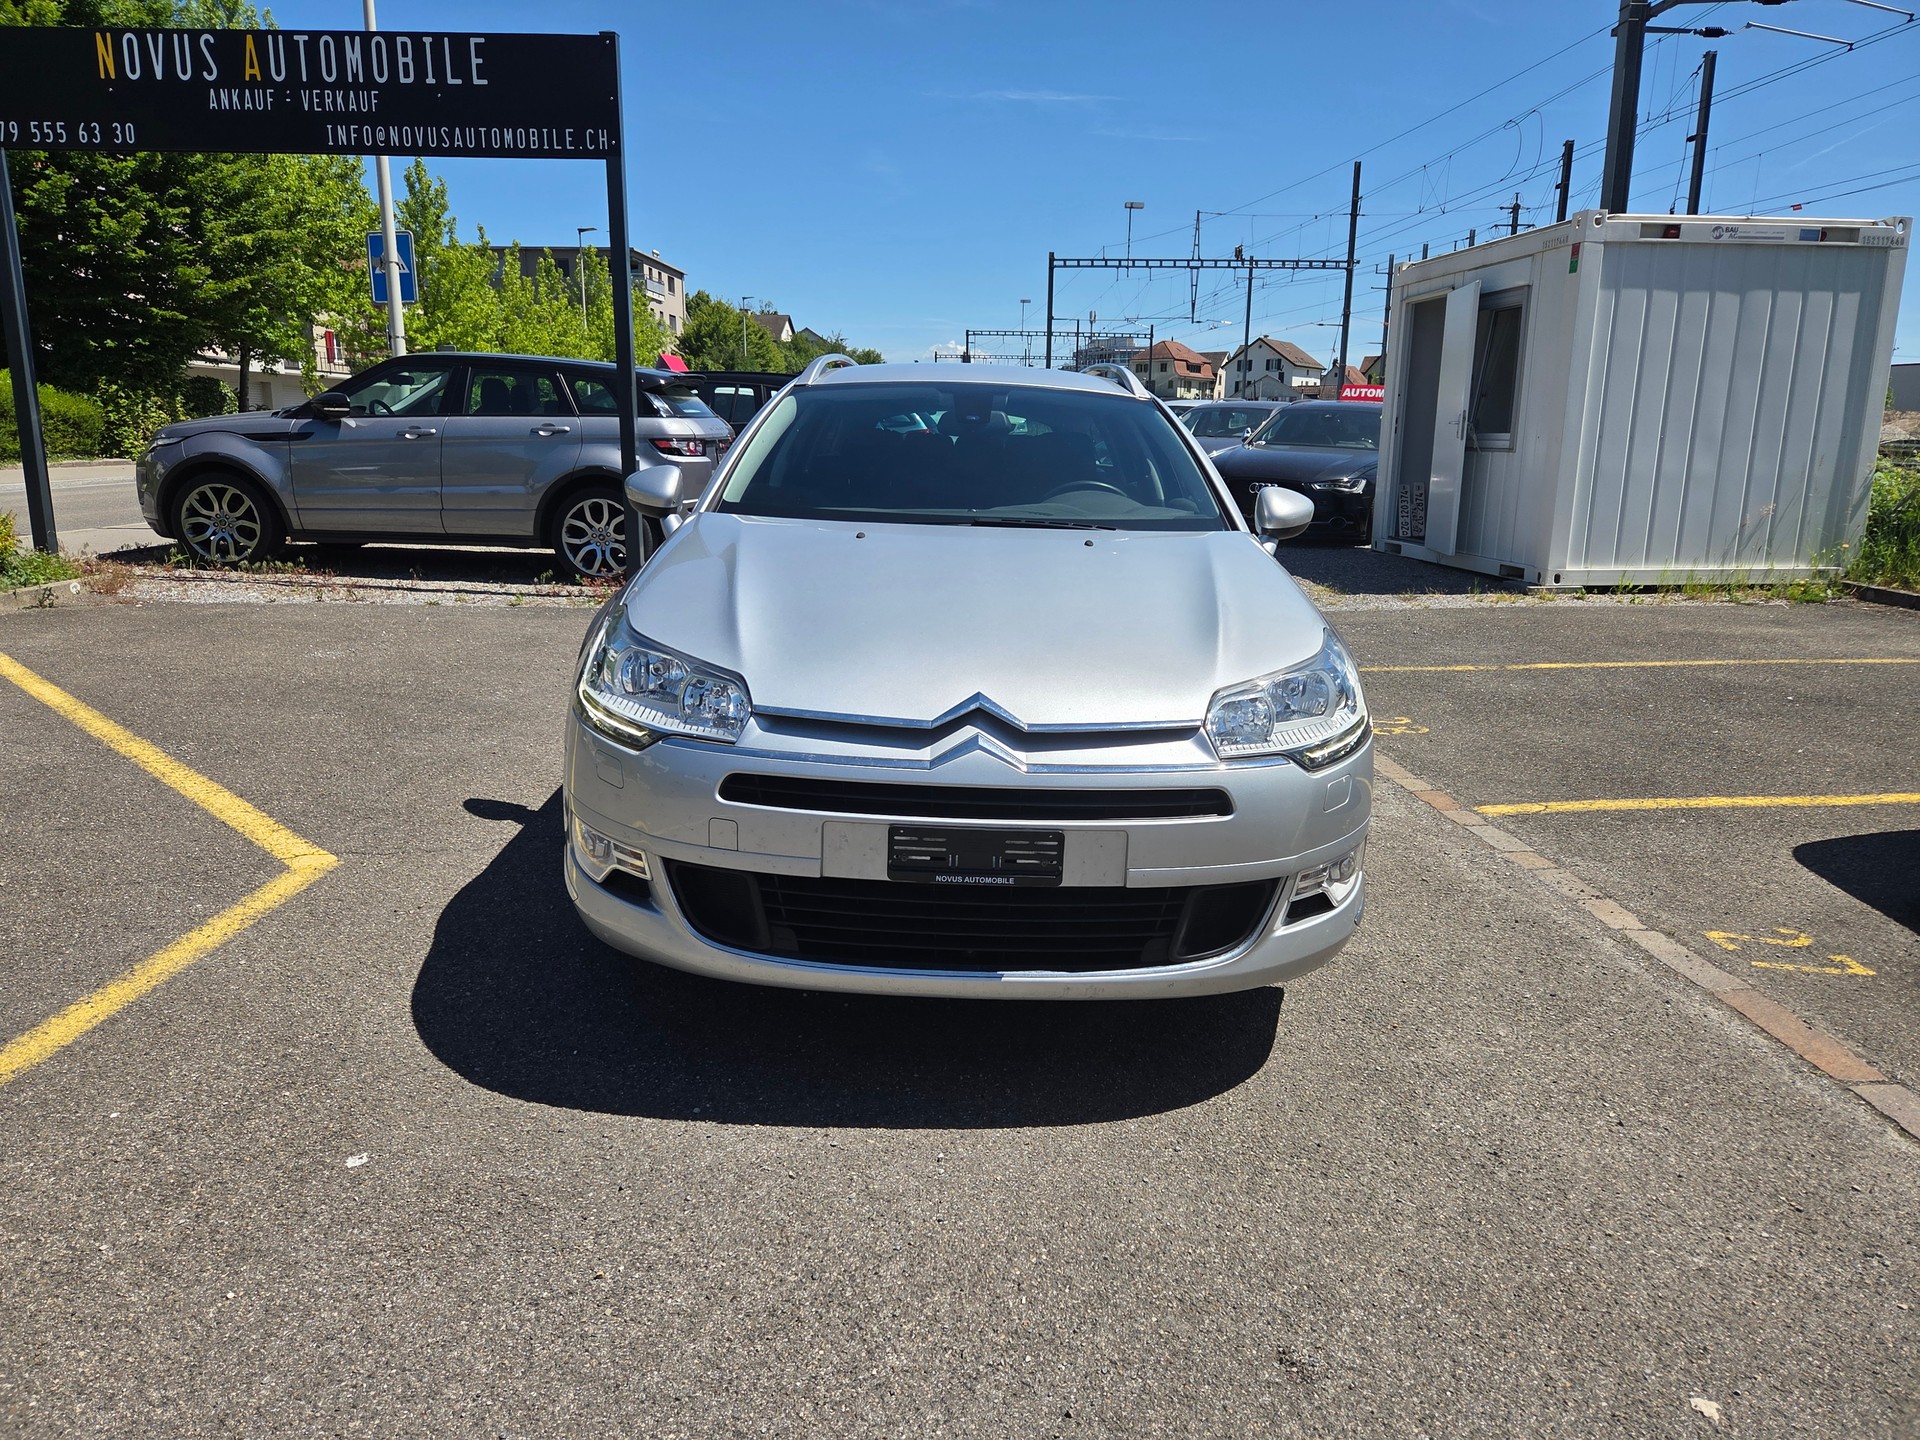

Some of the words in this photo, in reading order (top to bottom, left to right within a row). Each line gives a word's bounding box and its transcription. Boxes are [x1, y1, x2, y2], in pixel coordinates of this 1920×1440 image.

[95, 31, 219, 81] NOVUS
[244, 34, 488, 85] AUTOMOBILE
[209, 89, 274, 111] ANKAUF
[301, 90, 380, 112] VERKAUF
[30, 121, 66, 143] 555
[79, 122, 101, 144] 63
[112, 122, 135, 144] 30
[326, 124, 609, 151] INFO@NOVUSAUTOMOBILE.CH
[1342, 388, 1384, 397] AUTOM
[935, 875, 962, 883] NOVUS
[964, 876, 1014, 884] AUTOMOBILE
